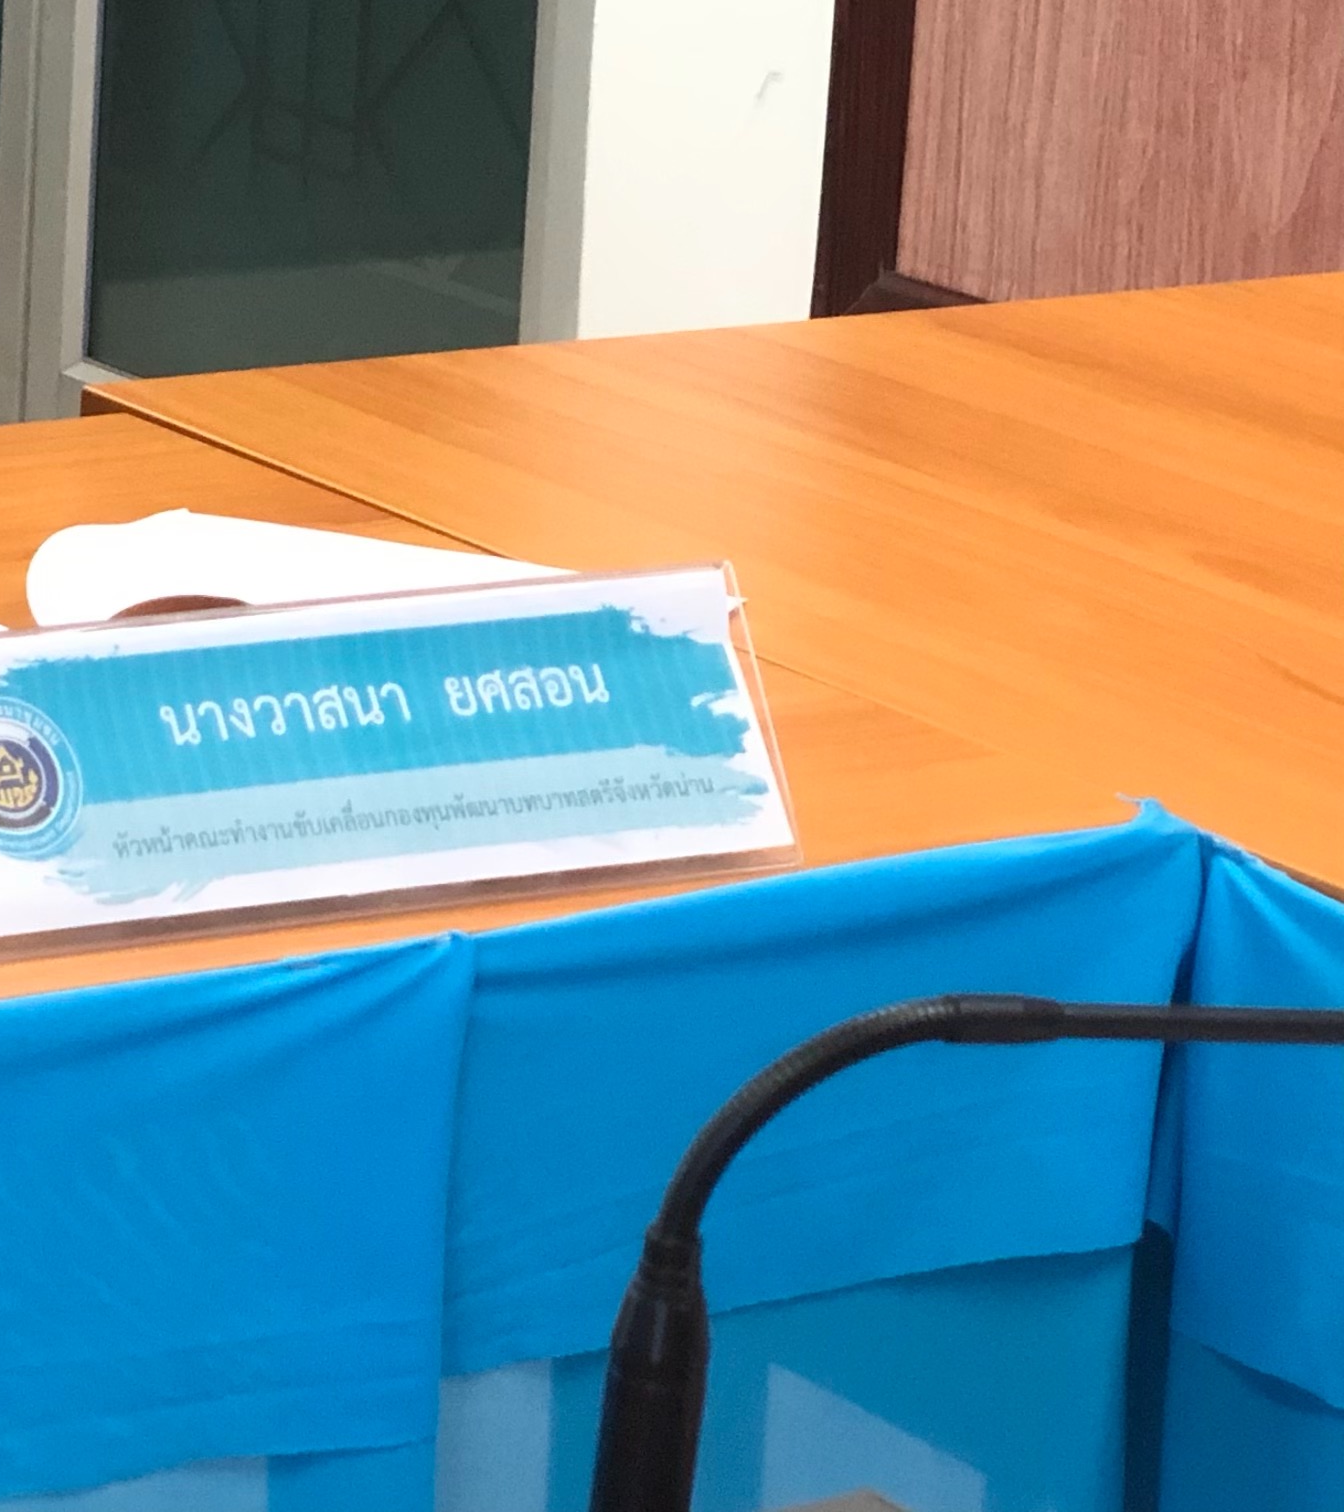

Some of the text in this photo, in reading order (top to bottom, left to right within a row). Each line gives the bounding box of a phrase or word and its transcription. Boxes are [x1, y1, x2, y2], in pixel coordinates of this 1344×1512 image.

[159, 663, 611, 745] นางวาสนา ยศสอน
